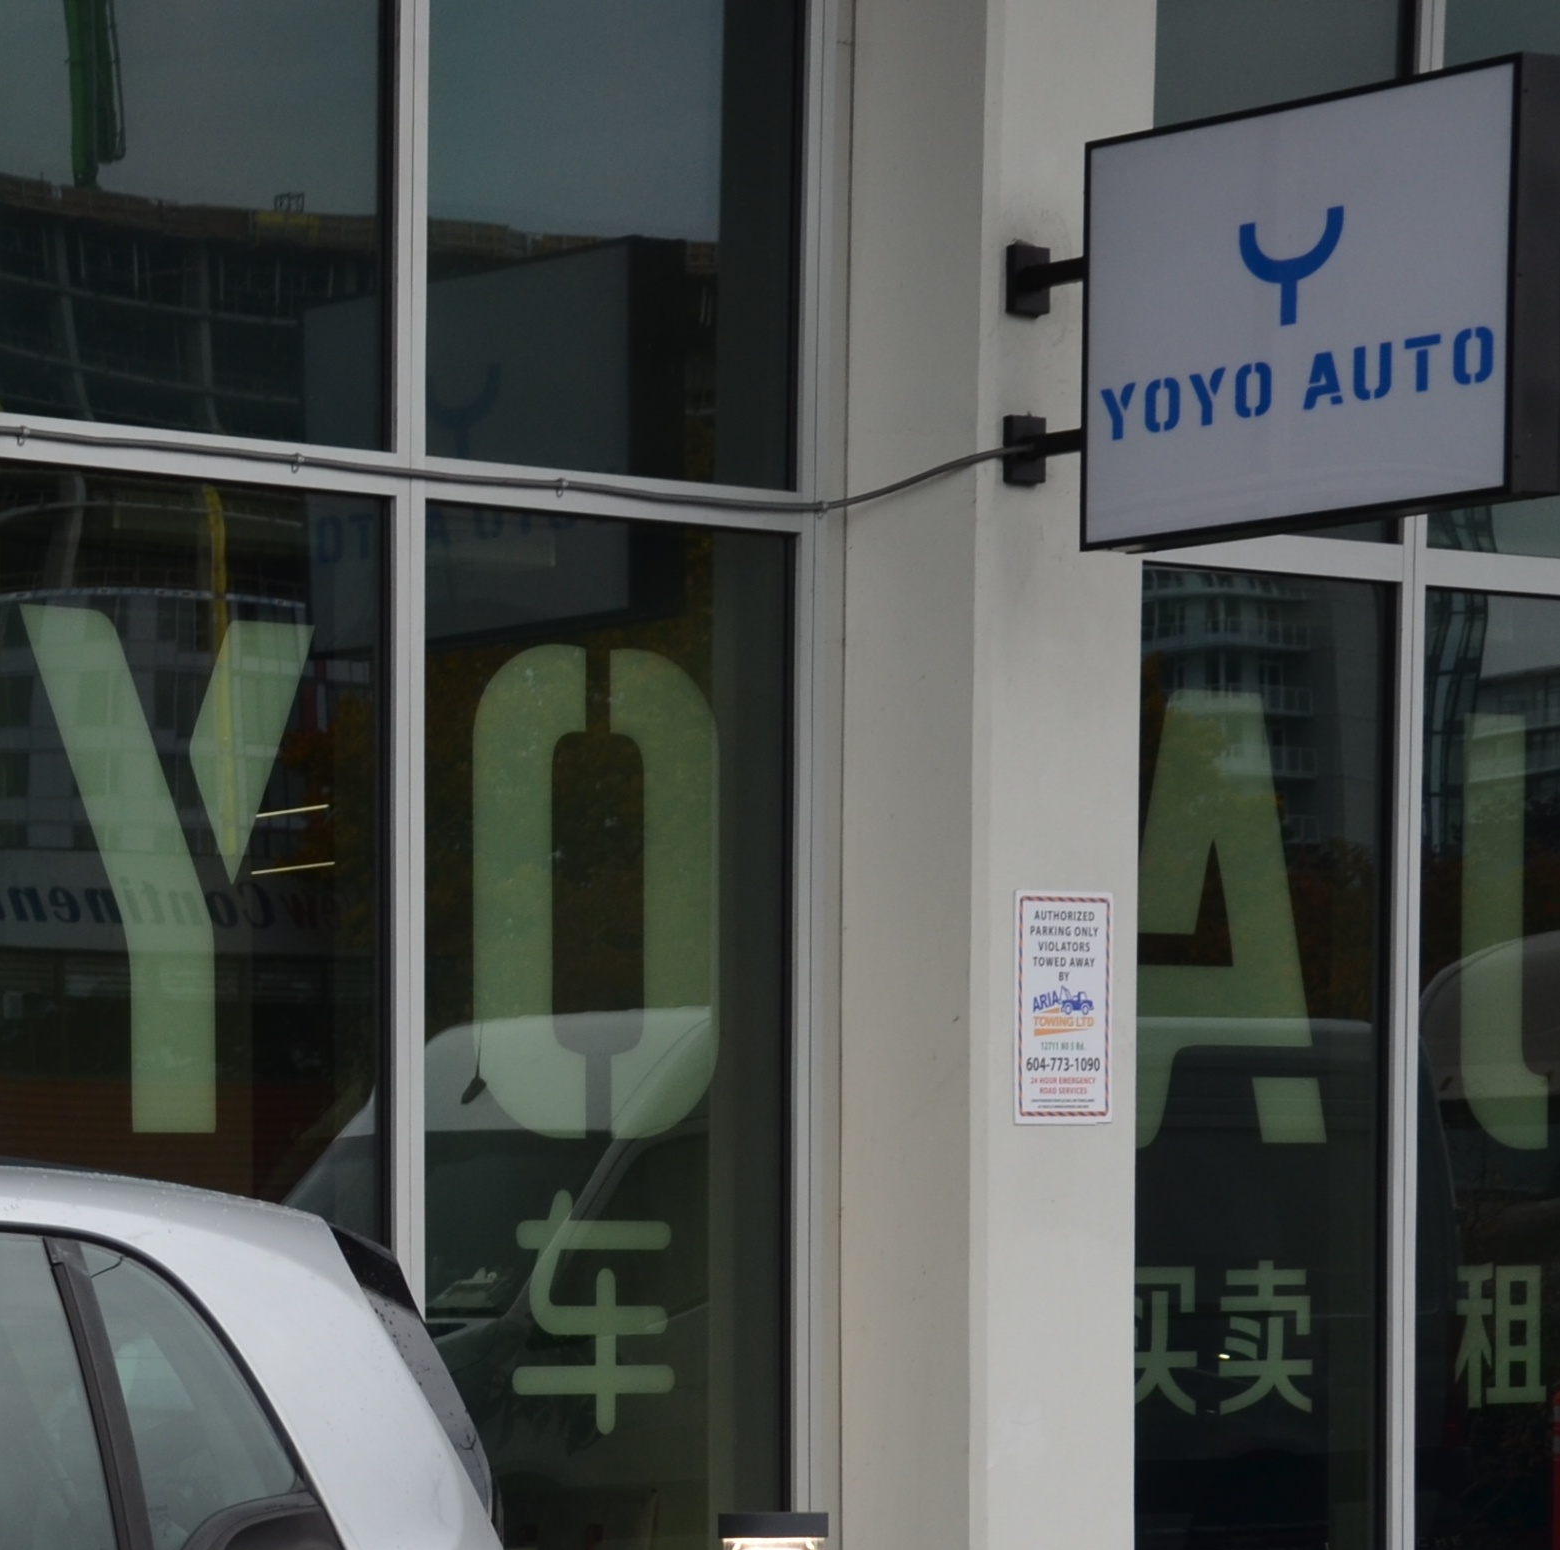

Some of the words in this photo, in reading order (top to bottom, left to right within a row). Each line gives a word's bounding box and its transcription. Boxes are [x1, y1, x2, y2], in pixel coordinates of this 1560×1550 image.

[1100, 361, 1273, 441] YOYO
[1302, 326, 1495, 410] AUTO
[1034, 910, 1095, 922] AUTHORIZED
[1030, 926, 1071, 937] PARKING
[1075, 926, 1099, 938] ONLY
[1038, 941, 1090, 952] VIOLATORS
[1033, 956, 1067, 967] TOWED
[1069, 957, 1095, 968] AWAY
[1058, 972, 1069, 981] BY
[1033, 990, 1060, 1013] ARIA
[1033, 1016, 1074, 1027] TOWING
[1076, 1016, 1094, 1027] LTD
[1026, 1057, 1100, 1072] 604-773-1090
[512, 1189, 676, 1436] 车
[1455, 1262, 1548, 1409] 租
